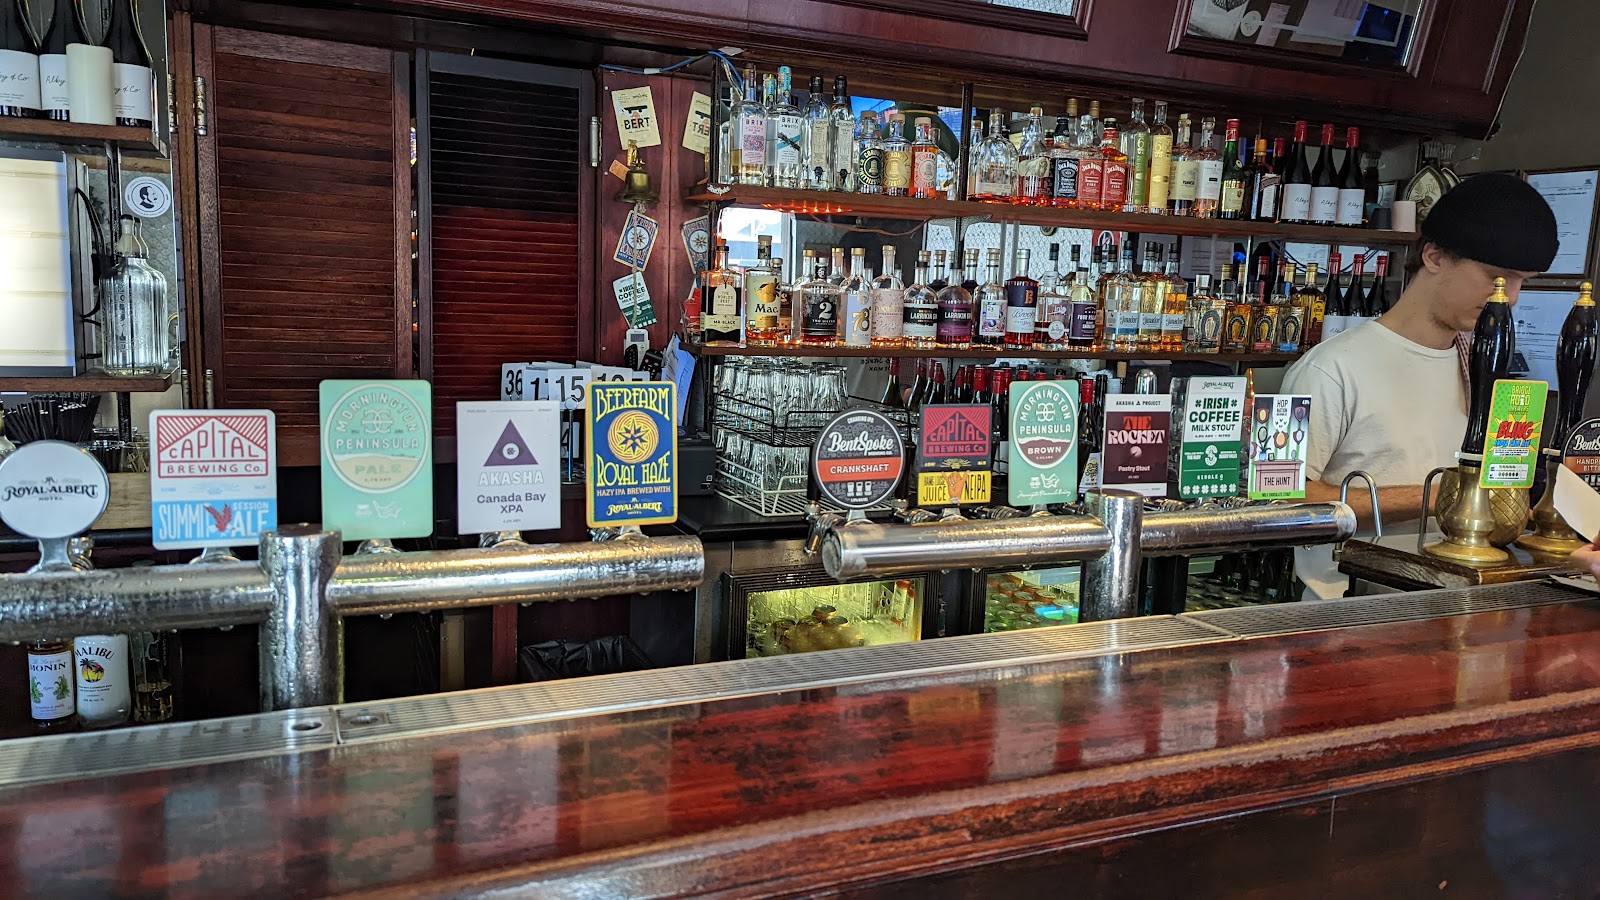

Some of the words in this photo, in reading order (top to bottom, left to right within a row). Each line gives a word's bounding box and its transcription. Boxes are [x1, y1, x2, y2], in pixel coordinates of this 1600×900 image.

[18, 73, 30, 81] Co
[130, 85, 142, 93] Co
[623, 117, 651, 130] BERT
[745, 118, 764, 126] BRIX
[781, 116, 799, 125] BRIX
[818, 302, 833, 319] 2
[505, 370, 522, 396] 36
[555, 376, 585, 403] 15
[1511, 385, 1531, 394] BRIDGE
[595, 388, 670, 422] BEERFARM
[1020, 390, 1071, 422] MORNINGTON
[1202, 398, 1229, 409] IRISH
[1276, 399, 1289, 407] HOP
[336, 392, 418, 432] MORNINGTON
[1189, 411, 1240, 423] COFFEE
[929, 412, 985, 442] CAPITAL
[1020, 423, 1071, 435] PENINSULA
[1191, 424, 1211, 432] MILK
[1211, 424, 1236, 432] STOUT
[1496, 421, 1534, 440] BLING
[169, 421, 260, 459] CAPITAL
[827, 430, 895, 456] BentSpoke
[1107, 429, 1166, 445] ROCKET
[336, 438, 419, 450] PENINSULA
[928, 445, 971, 453] BREWING
[1027, 446, 1062, 455] BROWN
[167, 464, 239, 474] BREWING
[244, 463, 264, 474] Co.
[354, 463, 401, 475] PALE
[596, 453, 638, 487] ROYAL
[641, 451, 671, 484] HAZE
[830, 463, 890, 474] CRANKSHAFT
[1118, 465, 1136, 473] Pastry
[478, 469, 545, 487] AKASHA
[1264, 477, 1275, 486] THE
[1275, 476, 1291, 486] HUNT
[2, 485, 47, 501] ROYAL
[47, 485, 99, 499] ALBERT
[597, 489, 614, 497] HAZY
[615, 488, 626, 496] IPA
[626, 487, 654, 495] BREWED
[653, 486, 671, 494] WITH
[965, 474, 987, 501] NEIPA
[476, 492, 522, 504] Canada
[525, 492, 547, 503] Bay
[923, 486, 947, 502] JUICE
[233, 502, 269, 510] SESSION
[500, 504, 524, 514] XPA
[606, 503, 633, 516] ROYAL
[633, 501, 663, 514] ALBERT
[158, 502, 212, 541] SUMMIT
[75, 646, 115, 660] MALIBU
[30, 662, 66, 671] MONIN
